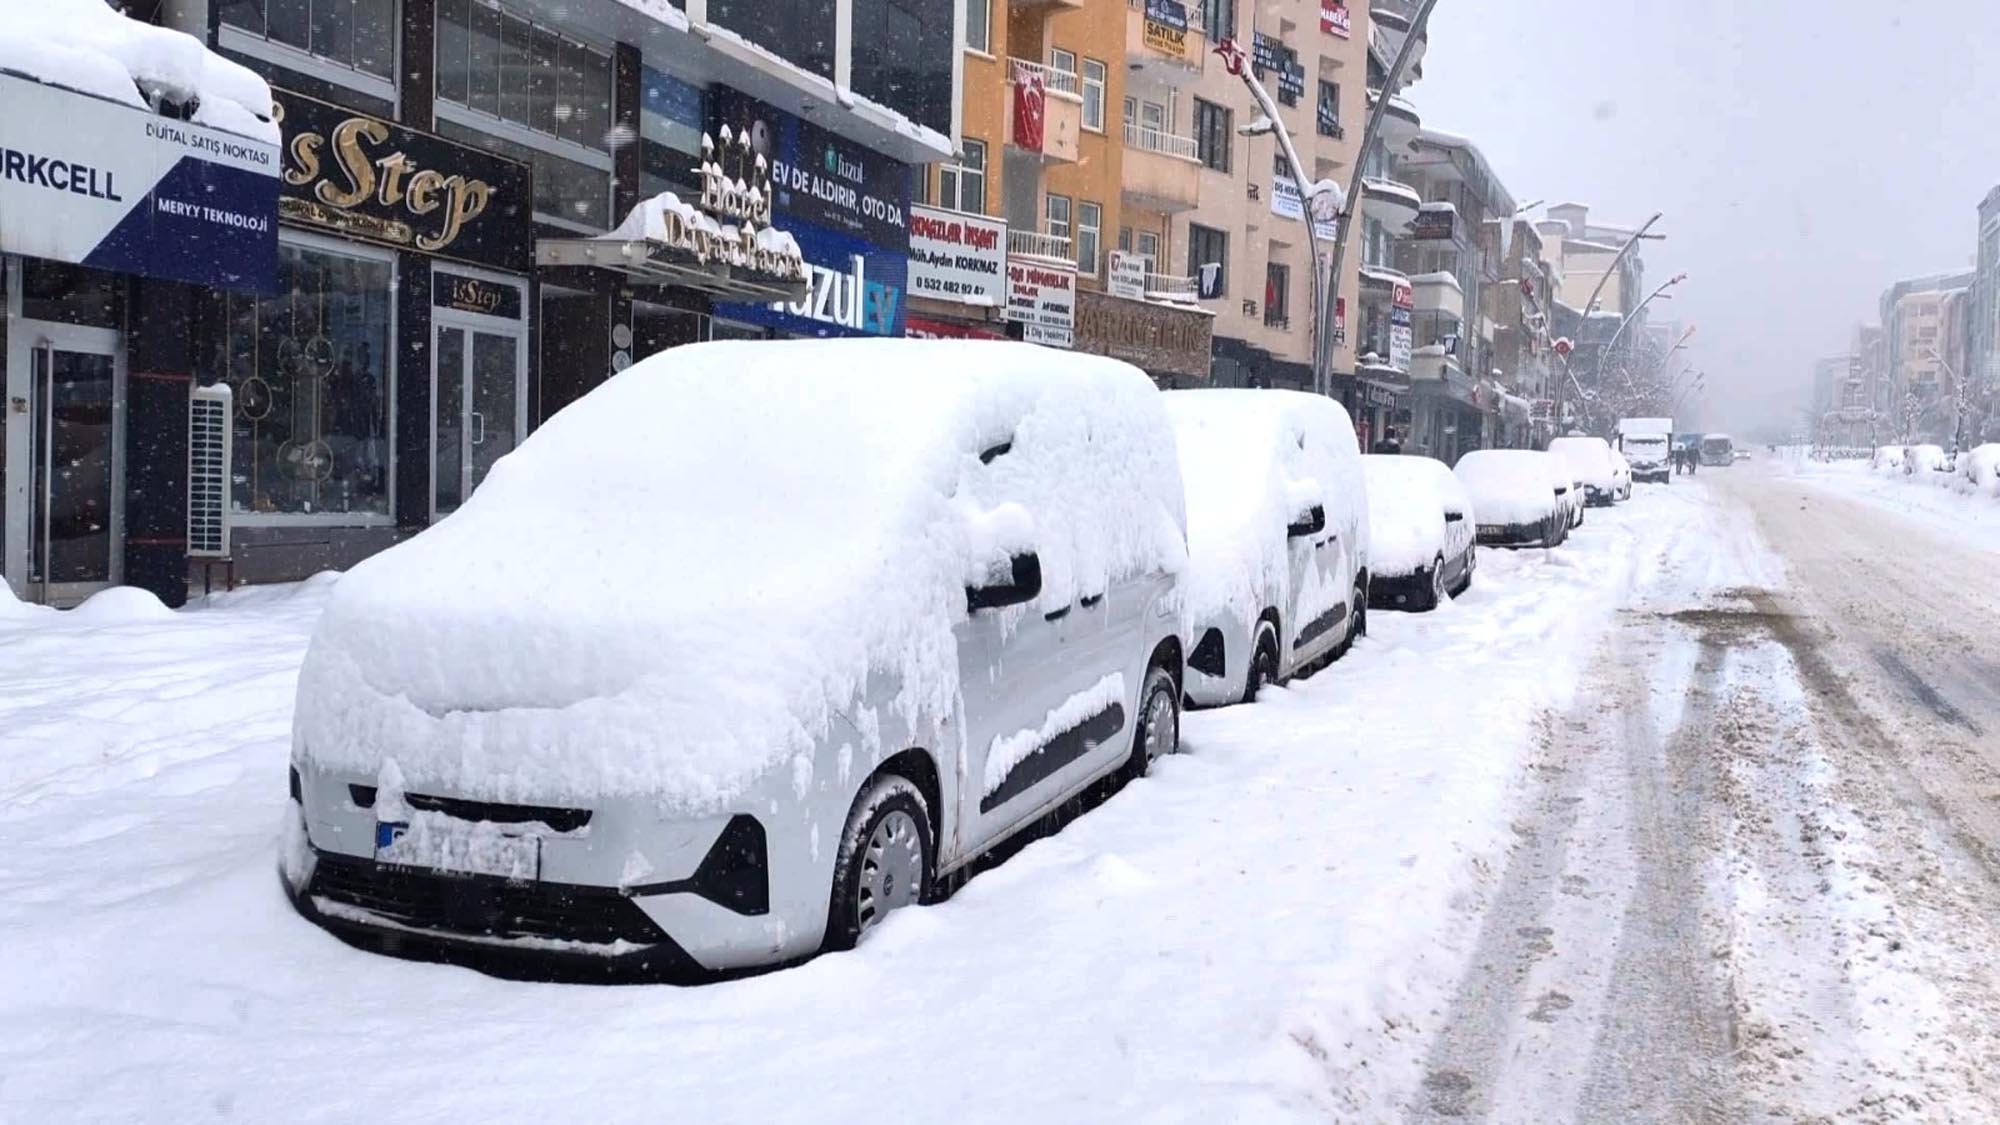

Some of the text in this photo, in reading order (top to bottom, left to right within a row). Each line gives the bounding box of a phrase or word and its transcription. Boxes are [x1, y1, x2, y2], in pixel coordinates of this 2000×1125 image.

[1147, 22, 1184, 46] SATILIK
[191, 135, 220, 156] SATIŞ
[223, 143, 269, 165] NOKTASI
[270, 101, 489, 250] sStep
[837, 153, 863, 184] fuzul
[702, 170, 771, 225] Hotel
[773, 160, 789, 185] EV
[792, 168, 809, 193] DE
[811, 176, 859, 215] ALDIRIR,
[862, 196, 886, 220] OTO
[888, 204, 905, 228] DA.
[158, 198, 201, 219] MERYY
[203, 207, 268, 232] TEKNOLOJİ
[964, 220, 998, 252] İNŞAAT
[955, 255, 998, 275] KORKMAZ
[1027, 268, 1069, 290] MİMARLIK
[453, 279, 502, 312] isStep
[916, 276, 922, 288] 0
[924, 278, 941, 291] 532
[943, 281, 960, 294] 482
